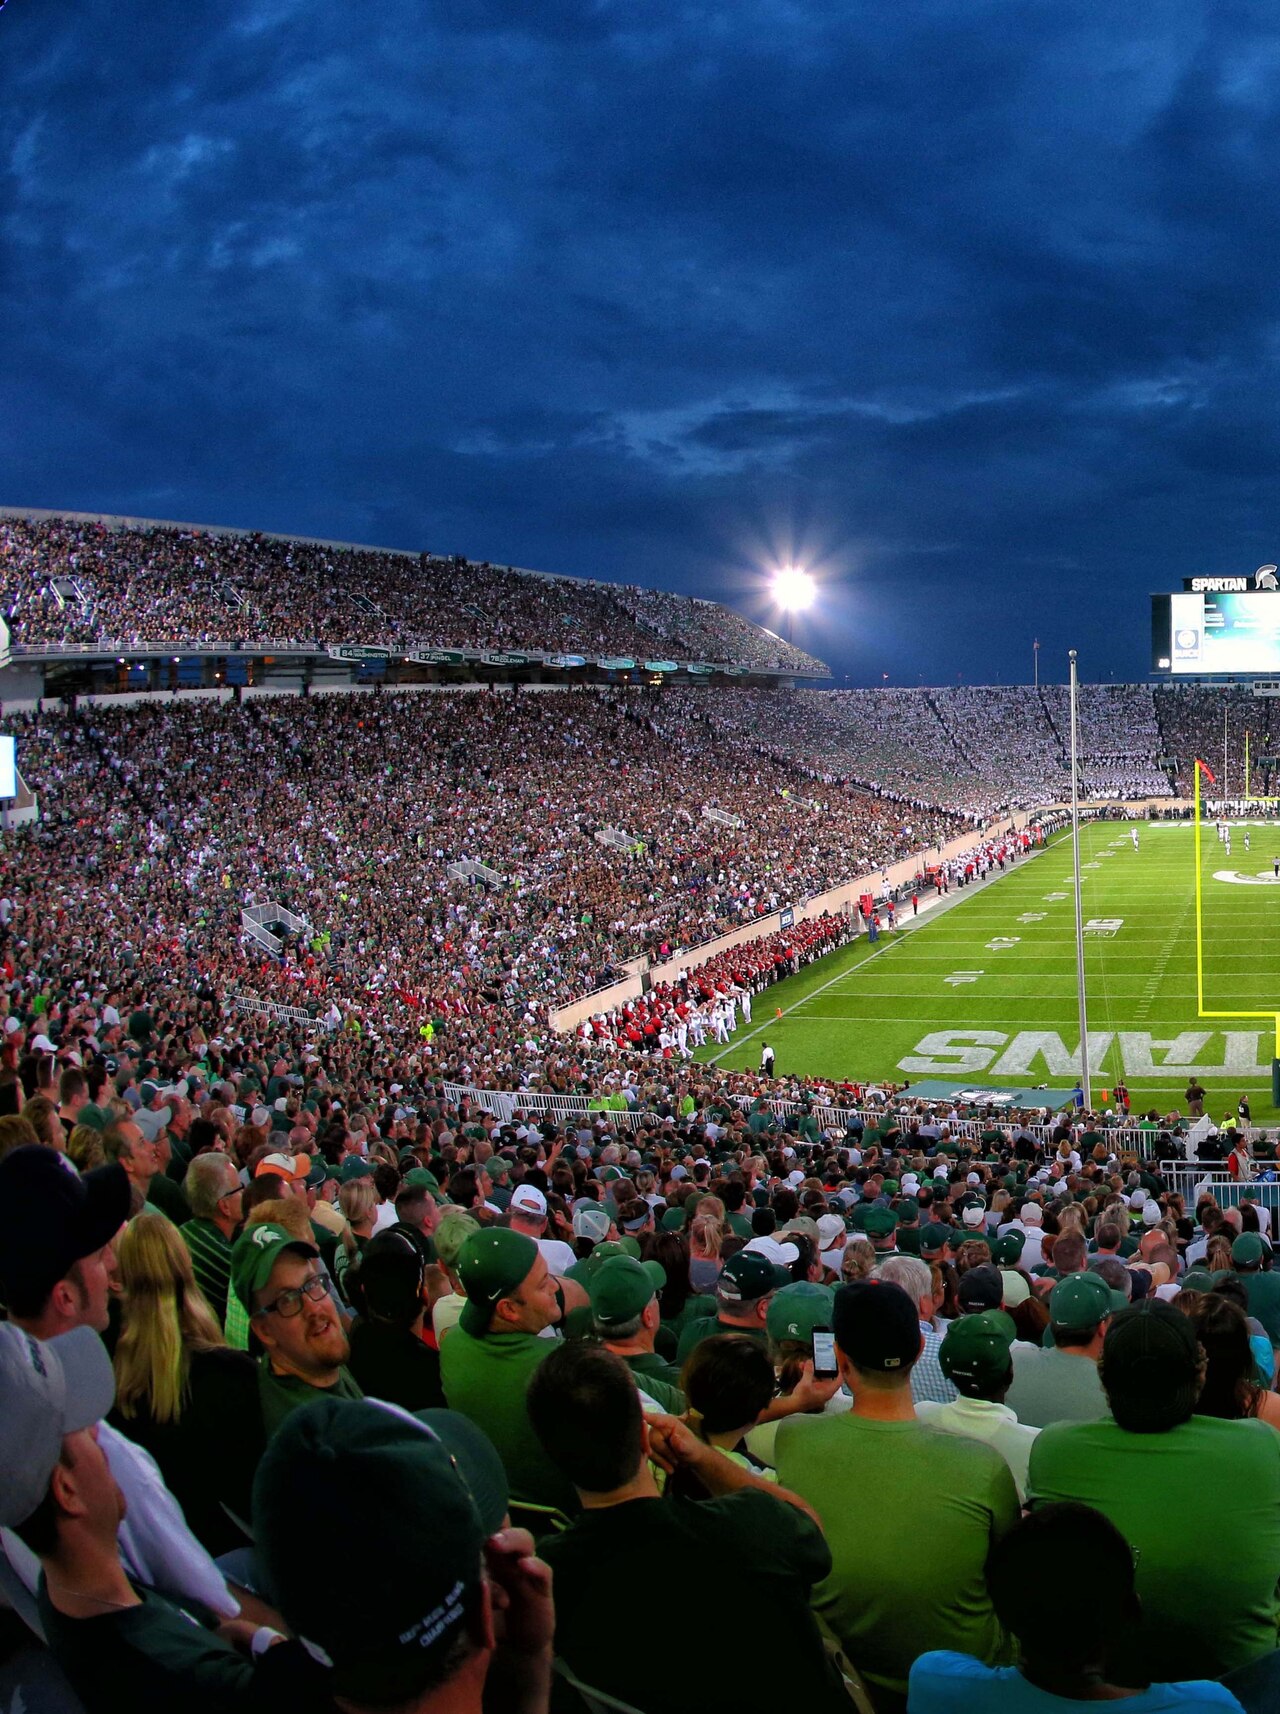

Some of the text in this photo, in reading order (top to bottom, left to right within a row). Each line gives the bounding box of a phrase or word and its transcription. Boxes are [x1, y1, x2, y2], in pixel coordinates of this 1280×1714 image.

[1191, 577, 1247, 591] SPARTAN
[1205, 800, 1278, 816] MICHIGAN
[943, 970, 984, 984] 10
